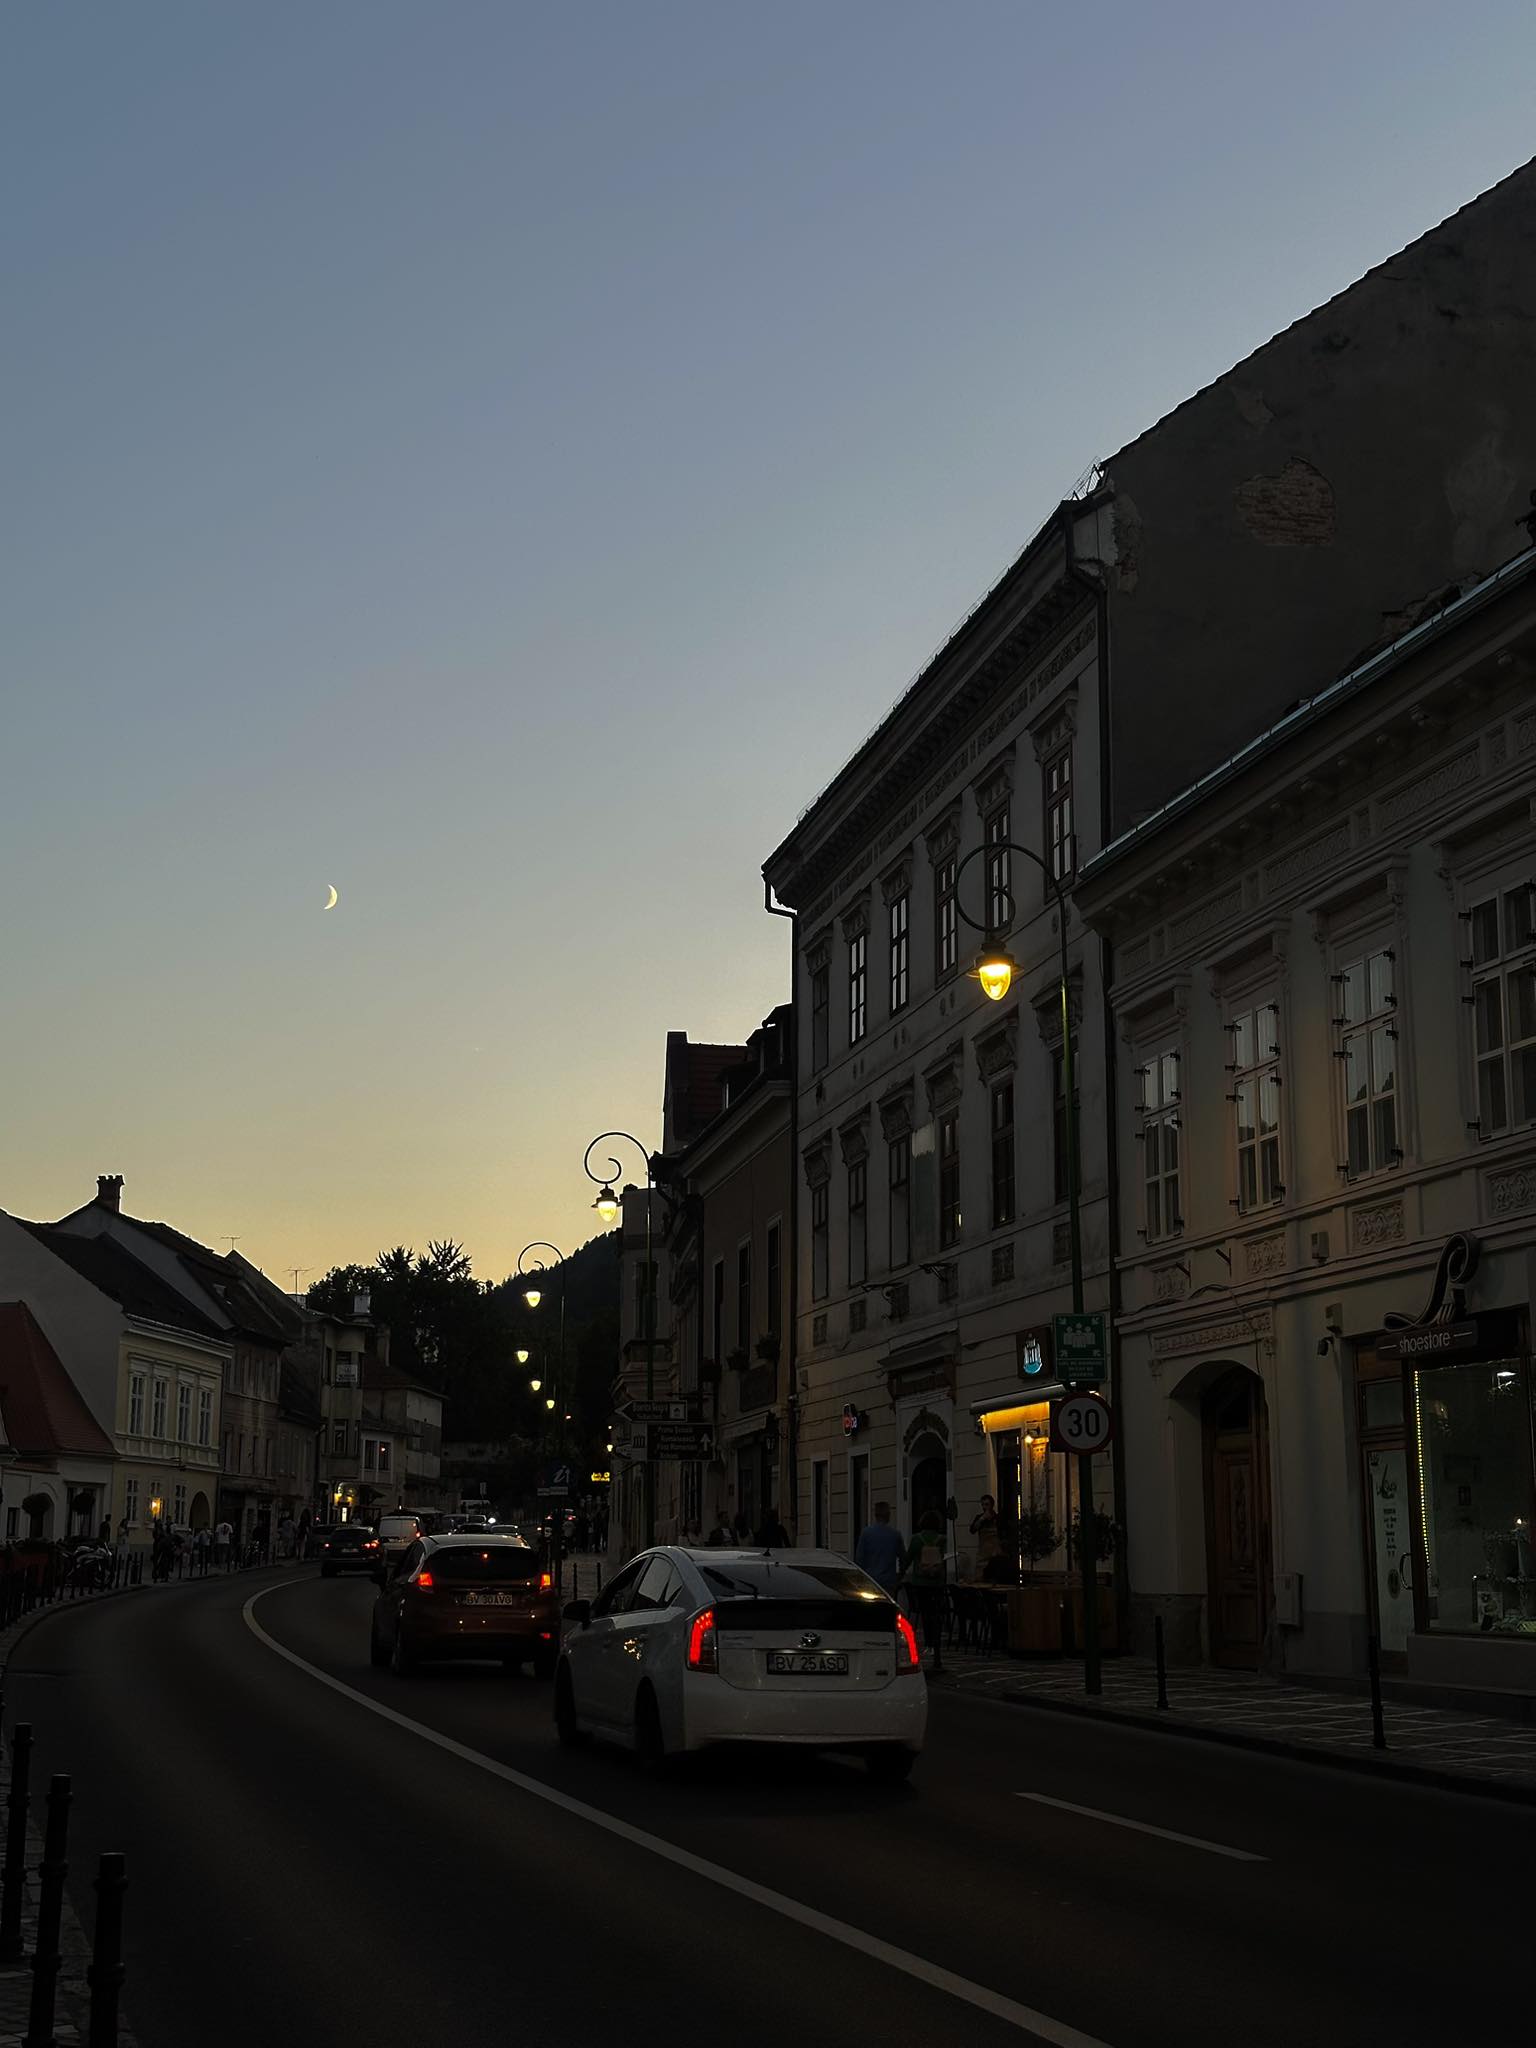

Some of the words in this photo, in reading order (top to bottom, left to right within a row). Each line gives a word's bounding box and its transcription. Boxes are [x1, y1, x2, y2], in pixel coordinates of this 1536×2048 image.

[1399, 1331, 1451, 1353] shoestore
[1067, 1408, 1100, 1437] 30
[775, 1656, 794, 1670] BV
[800, 1656, 817, 1670] 25
[819, 1656, 846, 1670] ASD
